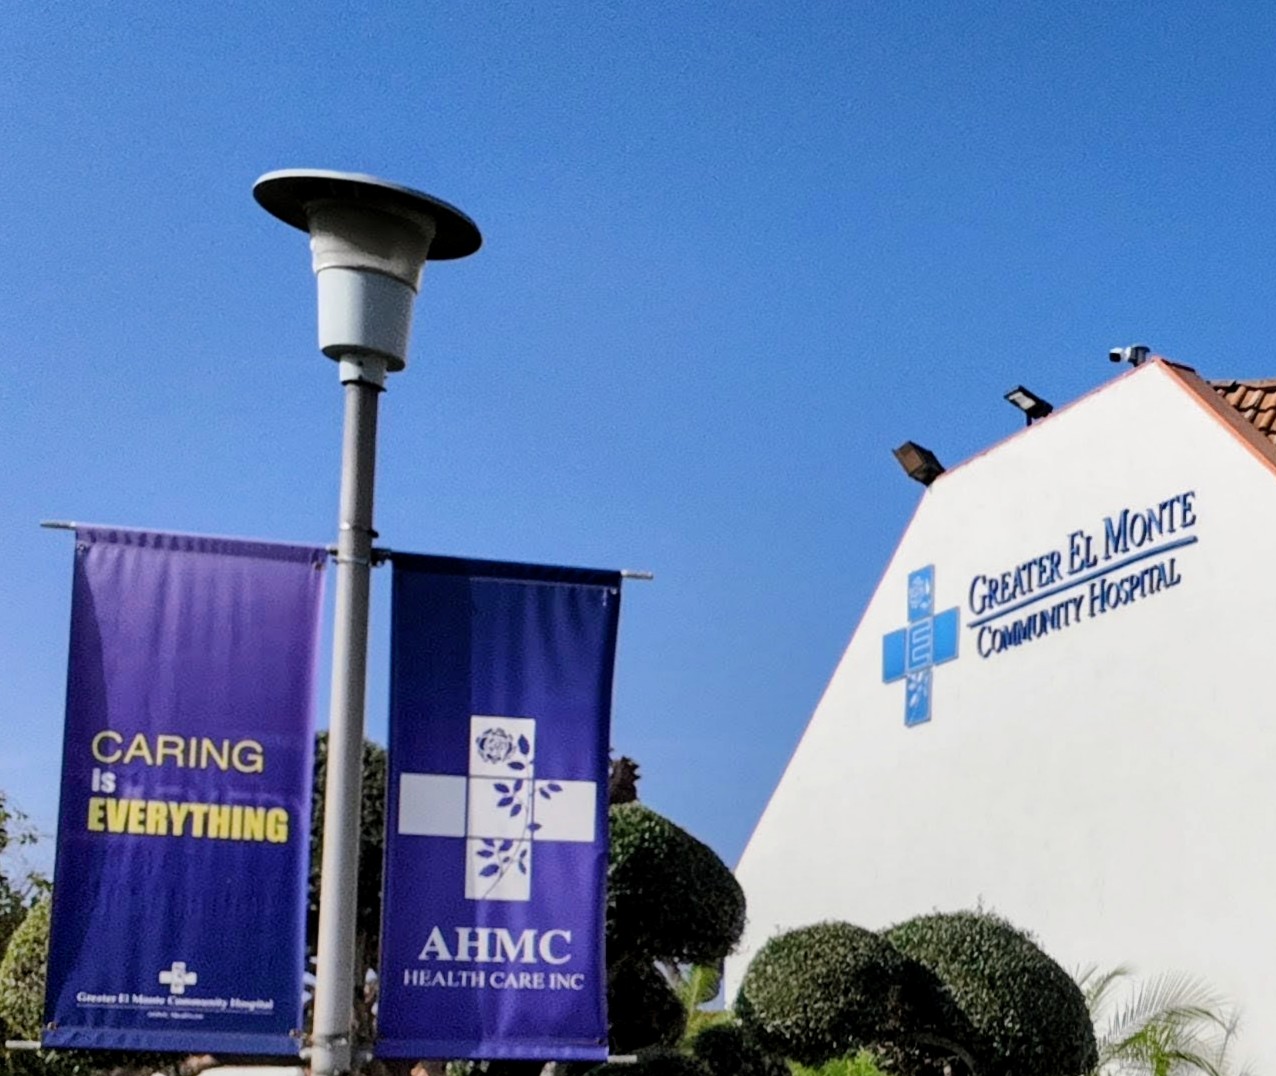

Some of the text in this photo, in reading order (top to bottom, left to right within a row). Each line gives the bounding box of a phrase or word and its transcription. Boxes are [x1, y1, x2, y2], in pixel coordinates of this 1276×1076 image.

[968, 491, 1196, 615] GREATER EL MONTE
[977, 558, 1182, 658] COMMUNITY HOSPITAL
[91, 730, 264, 773] CARING
[87, 796, 289, 844] EVERYTHING
[418, 925, 572, 965] AHMC
[403, 969, 585, 990] HEALTH CARE INC
[76, 991, 117, 1004] Greater
[167, 996, 228, 1010] Community
[230, 998, 274, 1012] Hospital
